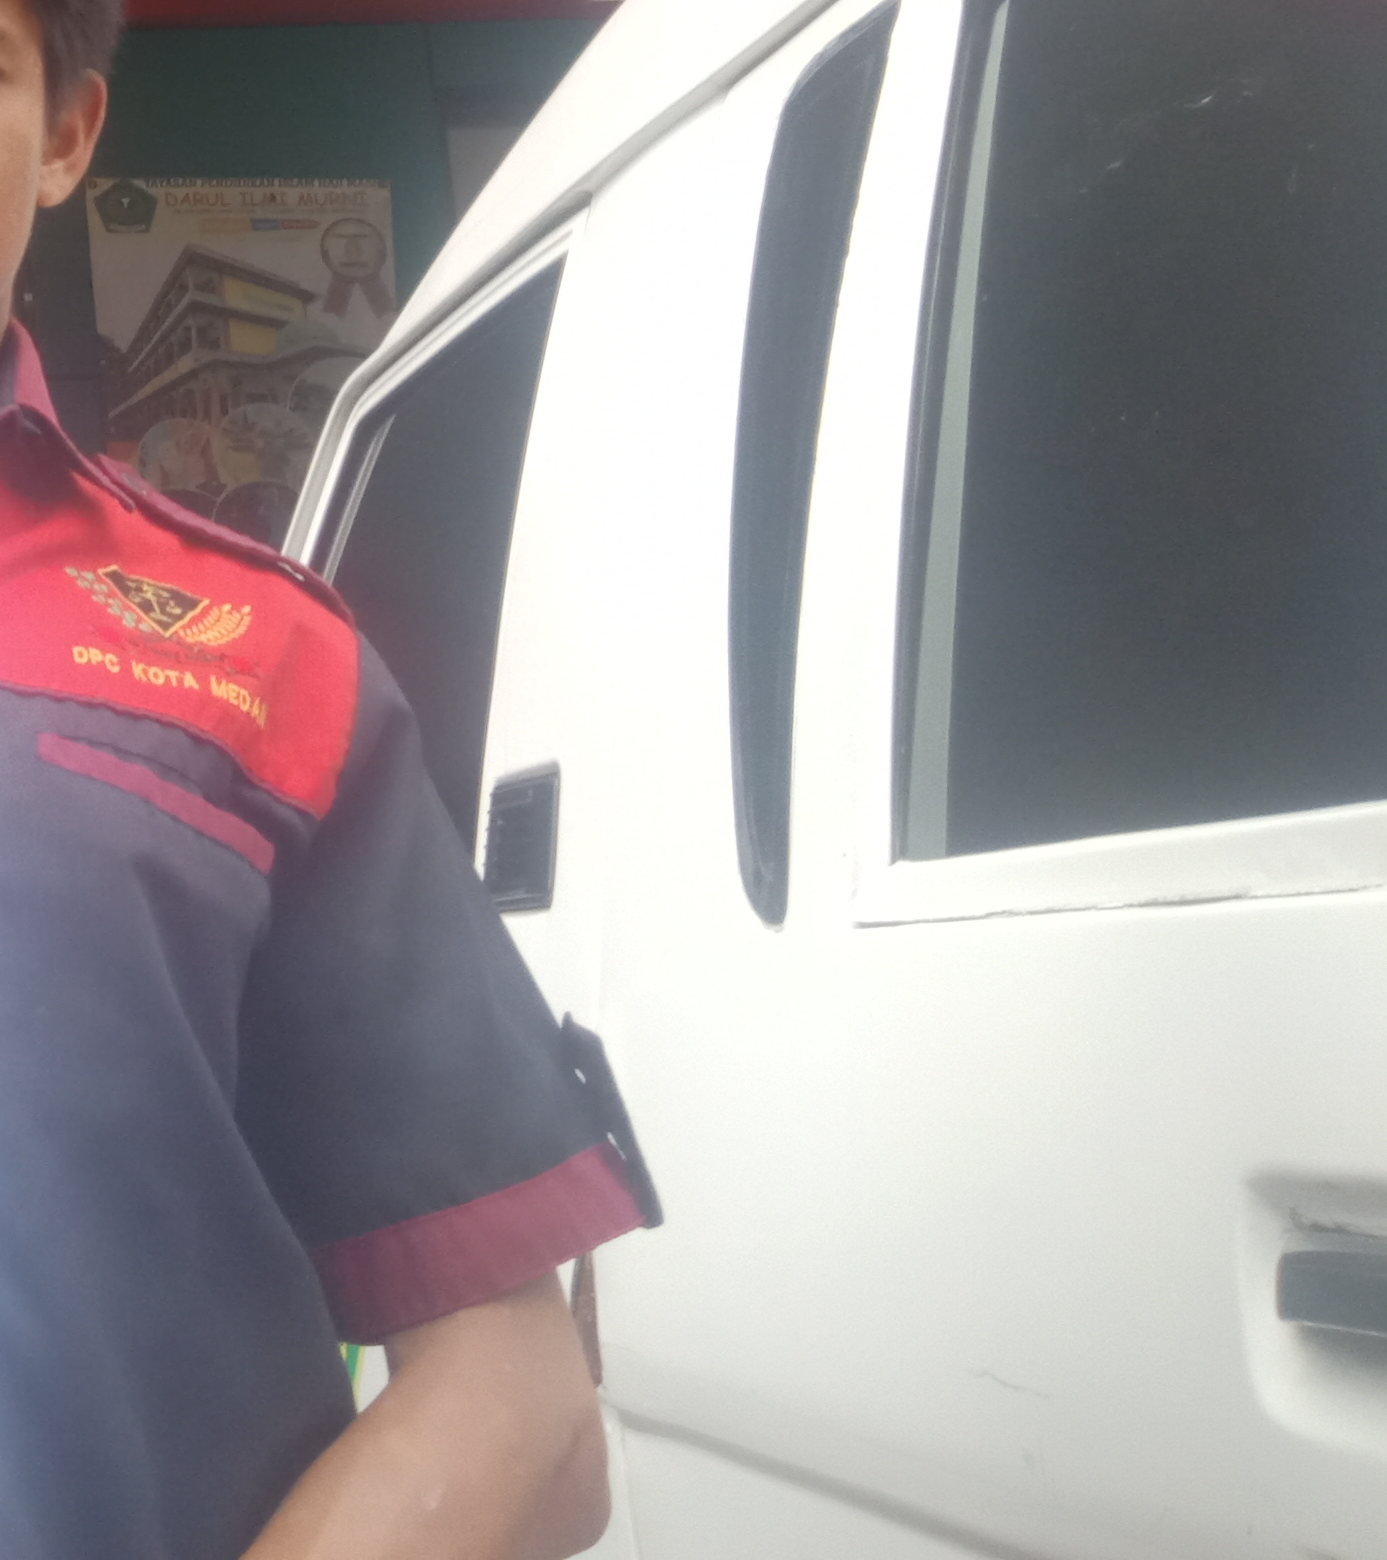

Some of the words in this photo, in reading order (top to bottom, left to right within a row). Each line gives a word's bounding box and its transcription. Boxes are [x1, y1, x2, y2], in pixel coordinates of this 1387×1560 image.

[164, 191, 232, 207] DARUL
[72, 646, 121, 673] DPC
[132, 662, 199, 690] KOTA
